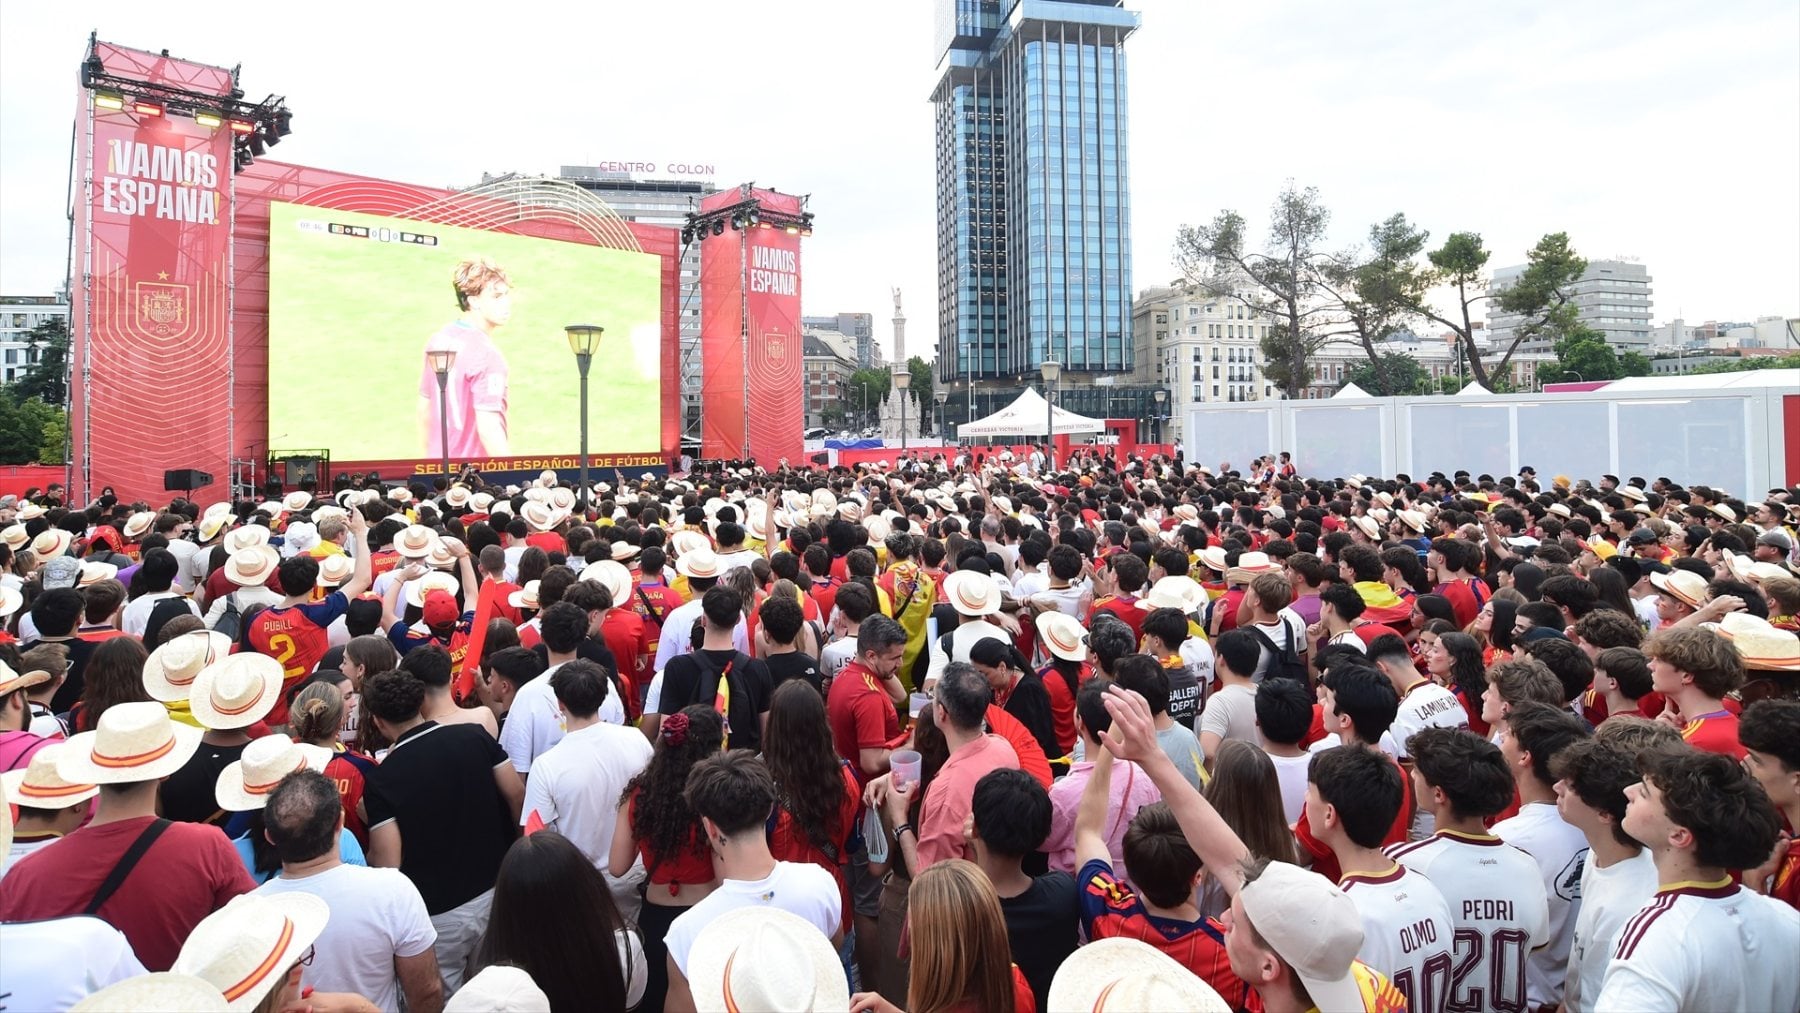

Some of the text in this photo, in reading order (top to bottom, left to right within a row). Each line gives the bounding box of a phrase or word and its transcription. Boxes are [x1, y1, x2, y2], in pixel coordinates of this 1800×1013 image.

[107, 138, 218, 188] ¡VAMOS
[599, 161, 715, 175] CENTRO COLON
[103, 175, 220, 225] ESPAÑA!
[594, 458, 613, 468] DE
[616, 455, 667, 467] FÚTBOL
[263, 618, 294, 633] PUBILL
[269, 633, 306, 679] 2
[1170, 699, 1196, 713] DEPT.
[1414, 697, 1449, 721] LAMINE
[1463, 899, 1514, 921] PEDRI
[1399, 917, 1437, 954] OLMO
[1446, 926, 1530, 1013] 20
